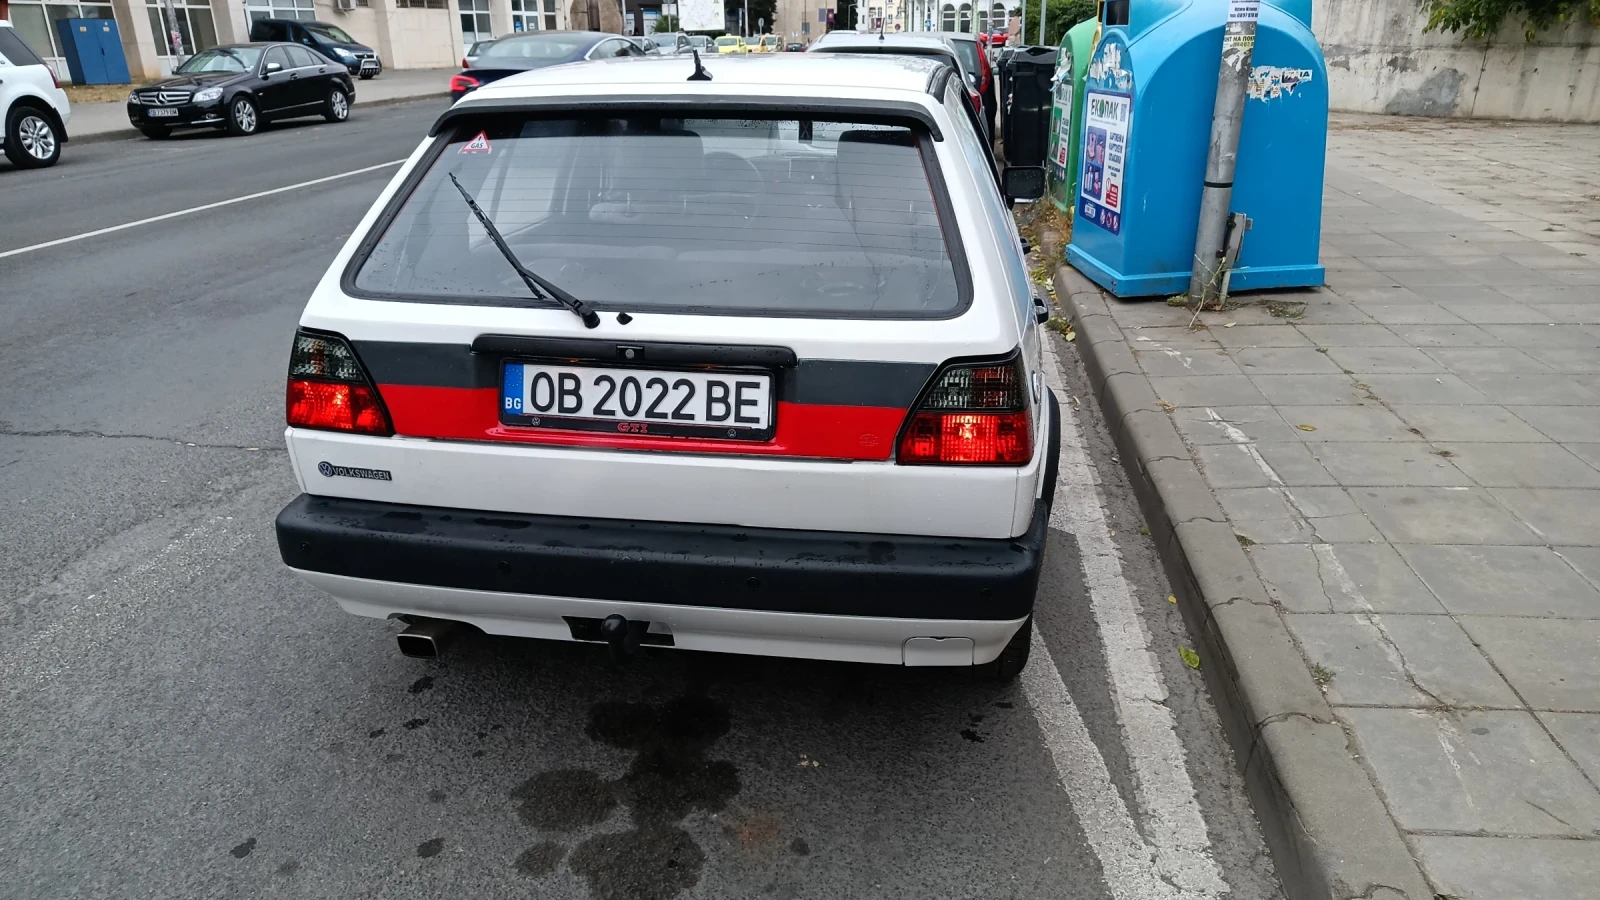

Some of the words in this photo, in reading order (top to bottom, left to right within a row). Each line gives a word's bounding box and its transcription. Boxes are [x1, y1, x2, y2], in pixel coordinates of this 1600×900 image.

[505, 396, 522, 411] BG
[530, 371, 583, 414] OB
[592, 374, 696, 421] 2022
[705, 379, 761, 424] BE
[617, 422, 648, 434] GTI
[333, 466, 390, 481] VOLKSWAGEN
